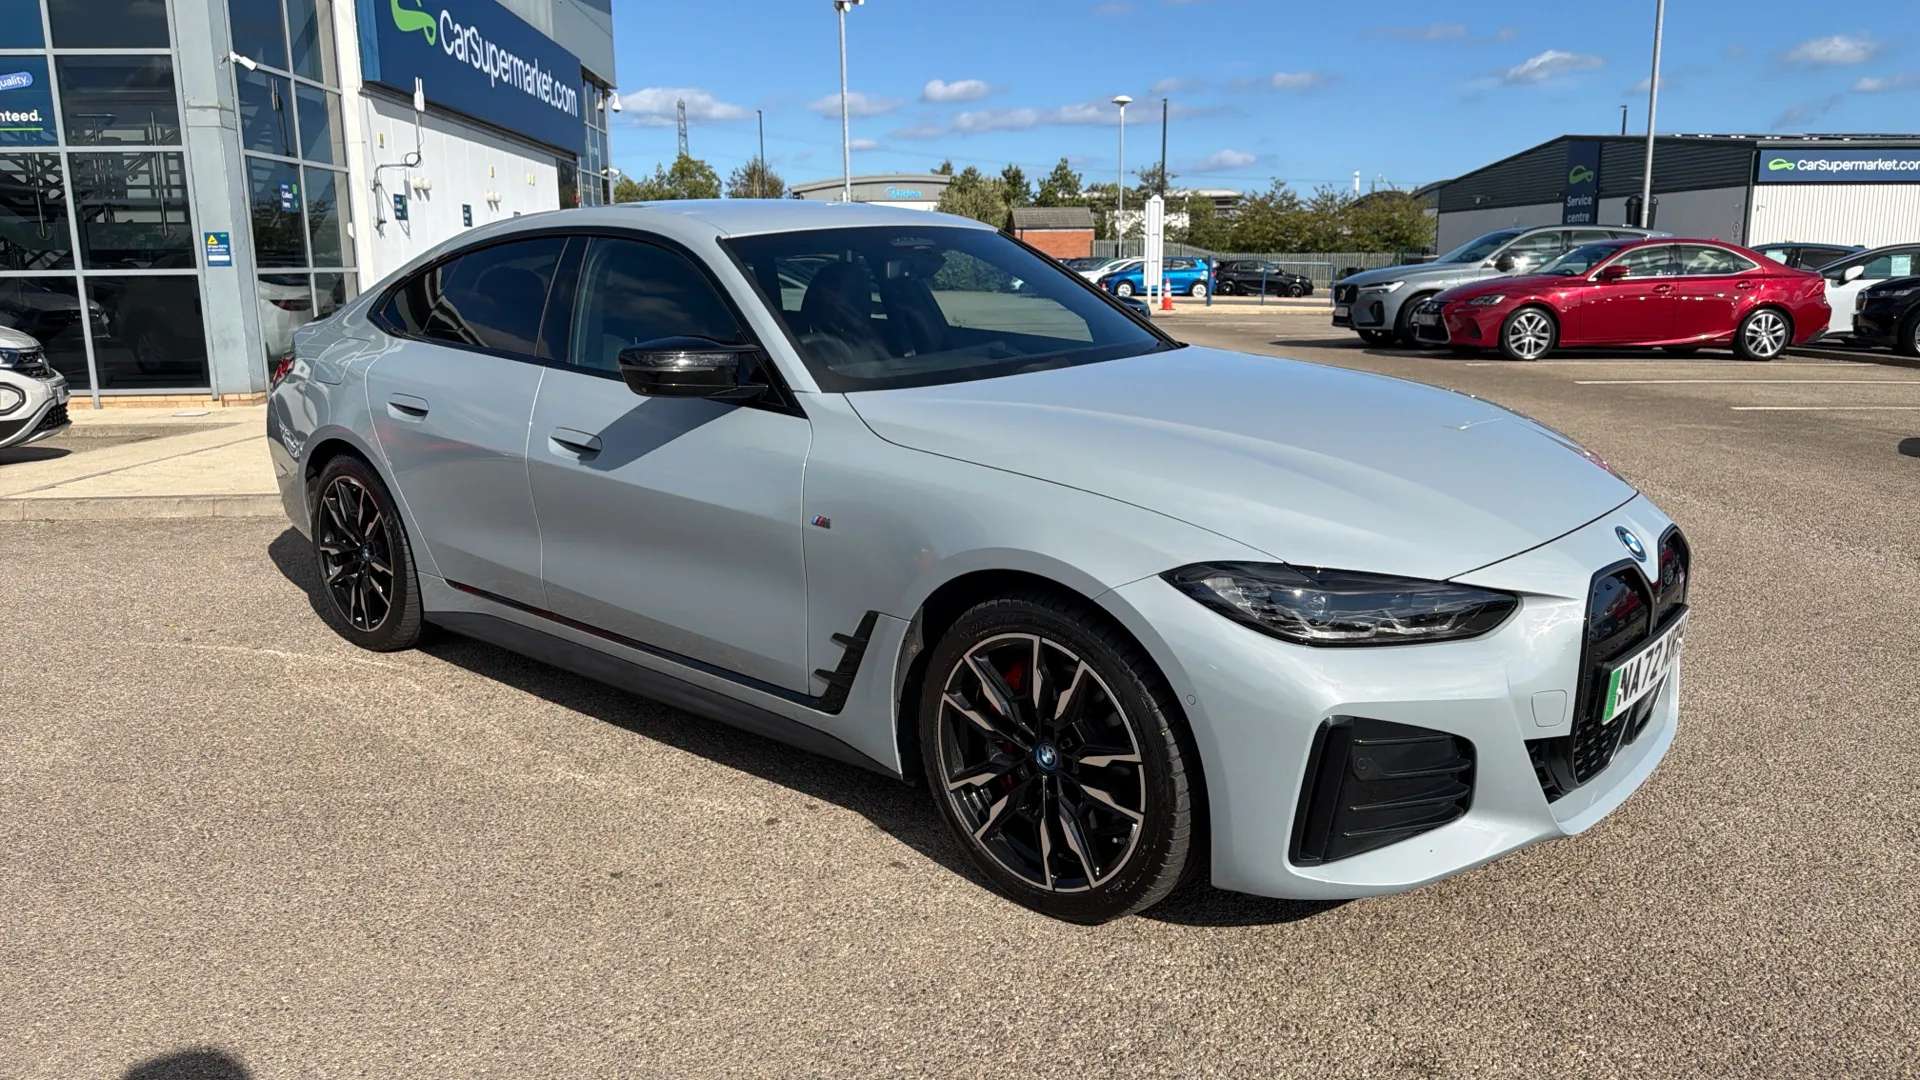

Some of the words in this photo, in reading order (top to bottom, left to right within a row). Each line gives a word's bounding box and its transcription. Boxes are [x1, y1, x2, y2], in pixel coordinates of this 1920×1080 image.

[439, 9, 578, 118] CarSupermarket.com
[1567, 194, 1593, 207] Service
[1567, 212, 1590, 223] centre
[1616, 640, 1663, 707] NA72
